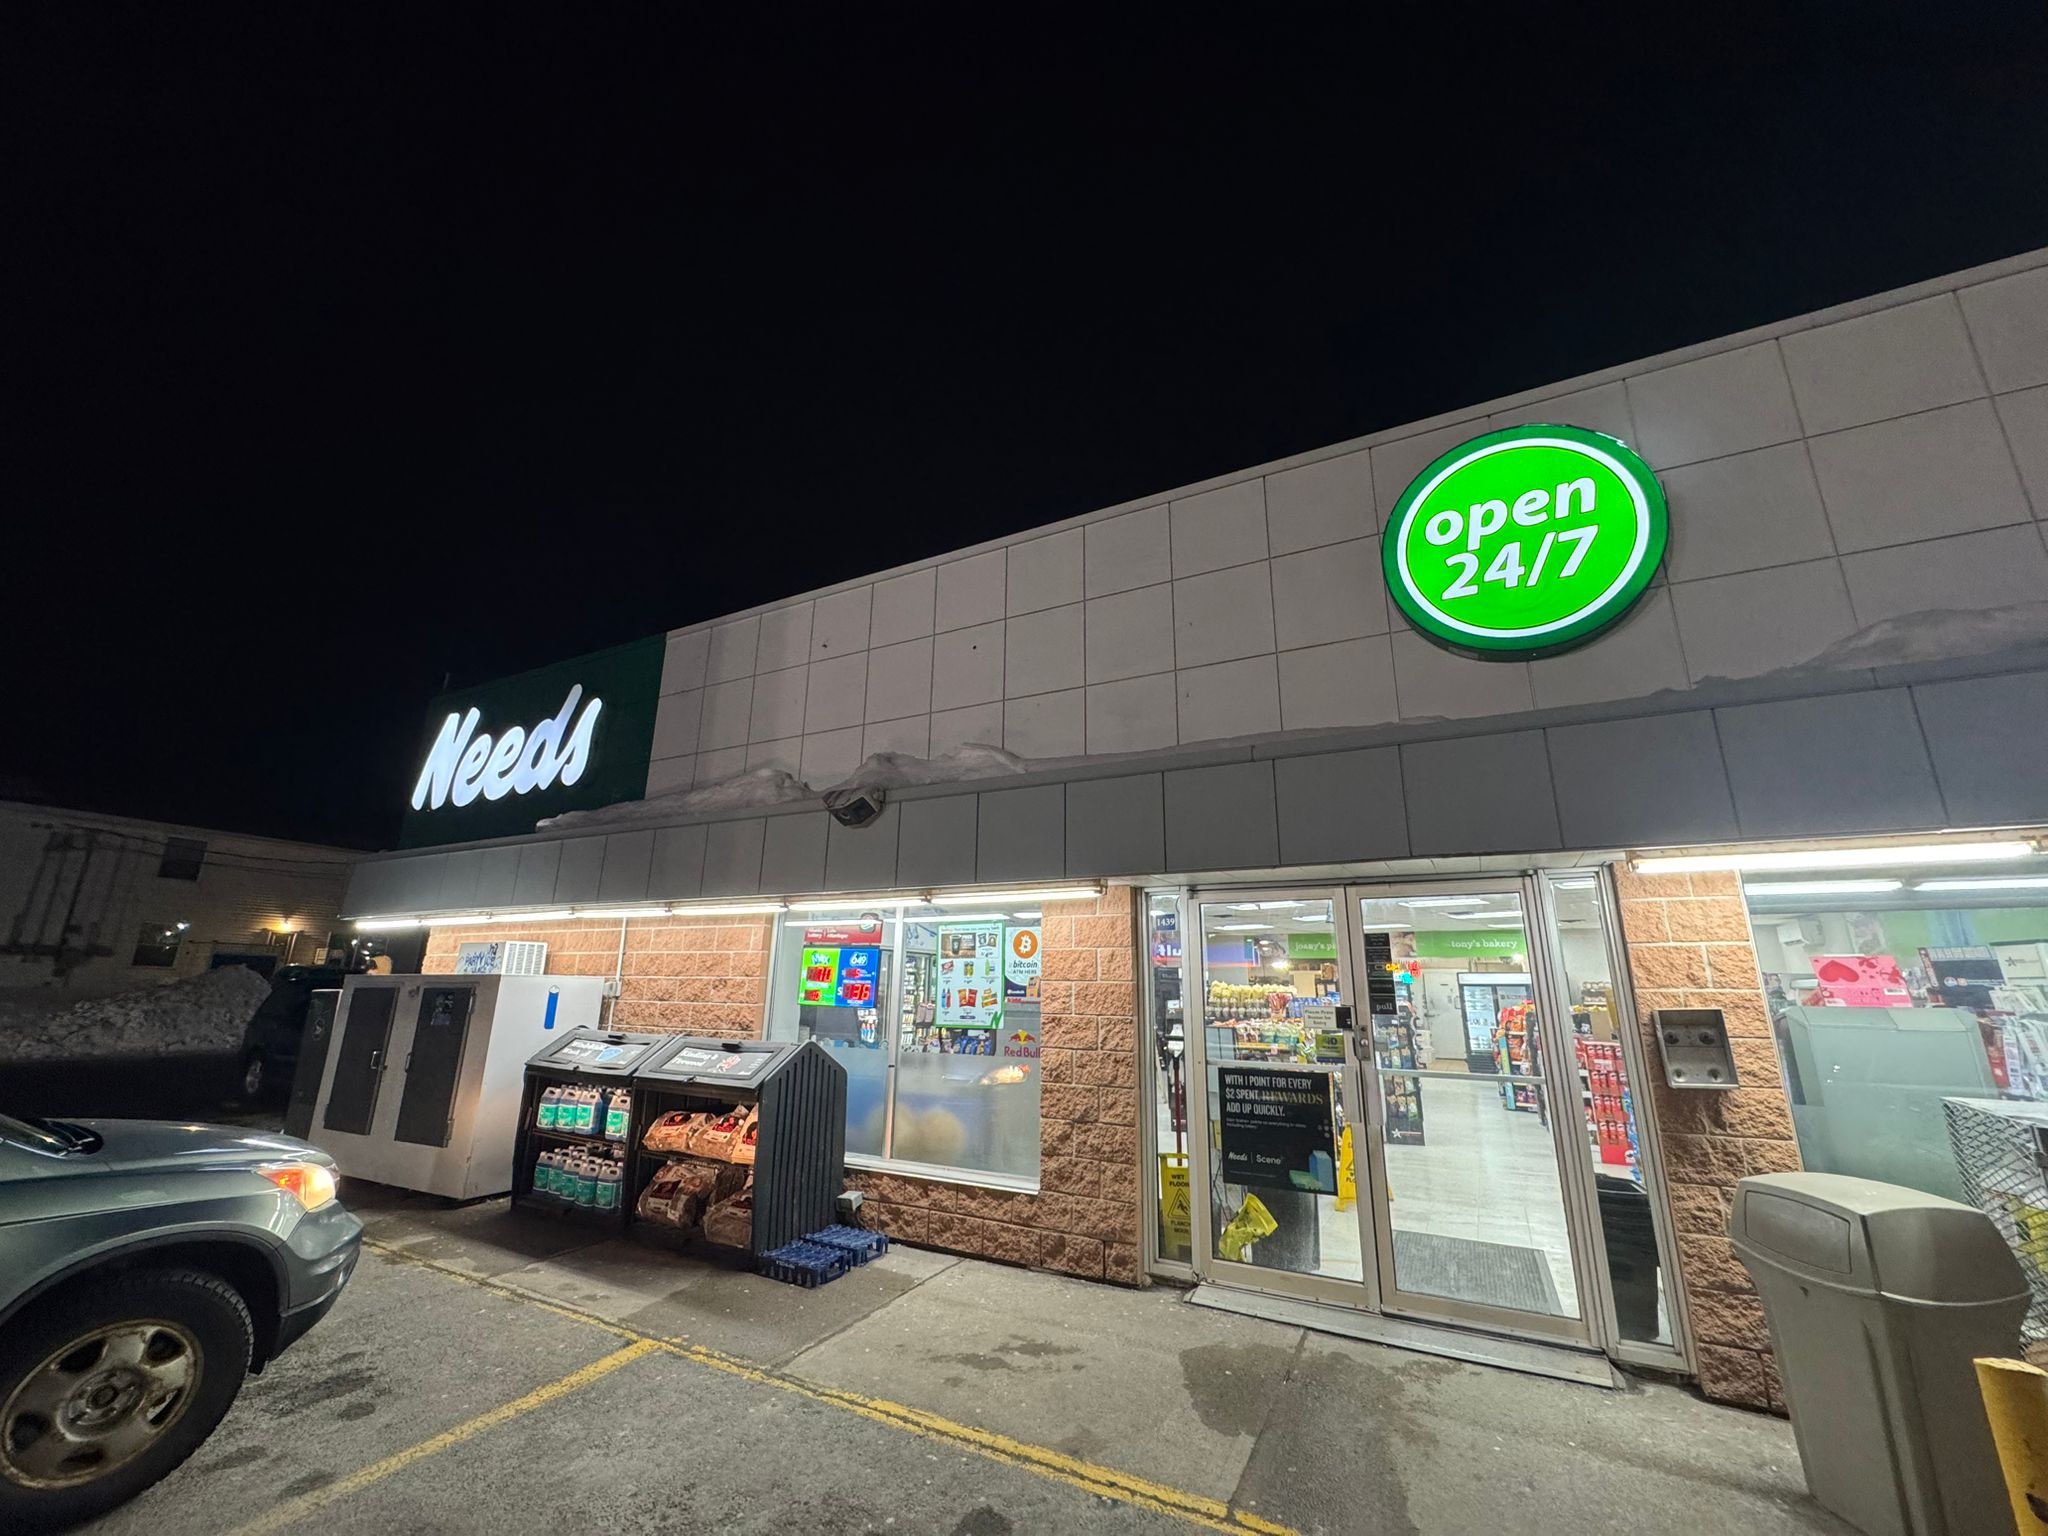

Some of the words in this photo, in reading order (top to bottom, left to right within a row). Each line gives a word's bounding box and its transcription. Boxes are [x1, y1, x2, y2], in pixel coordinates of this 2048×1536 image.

[1424, 477, 1597, 551] open
[1441, 524, 1599, 601] 24/7
[411, 683, 603, 811] Needs
[1156, 918, 1175, 927] 1439
[1451, 939, 1481, 950] tony's
[1482, 938, 1518, 950] bakery
[1012, 959, 1038, 969] bitcoin
[1004, 1046, 1023, 1057] Red
[1023, 1046, 1041, 1058] Bull
[1224, 1074, 1244, 1086] WITH
[1249, 1076, 1271, 1088] POINT
[1272, 1077, 1287, 1089] FOR
[1287, 1078, 1312, 1090] EVERY
[1225, 1087, 1235, 1099] $2
[1226, 1102, 1241, 1113] ADD
[1242, 1103, 1252, 1114] UP
[1252, 1105, 1286, 1117] QUICKLY.
[1227, 1151, 1248, 1162] Needs
